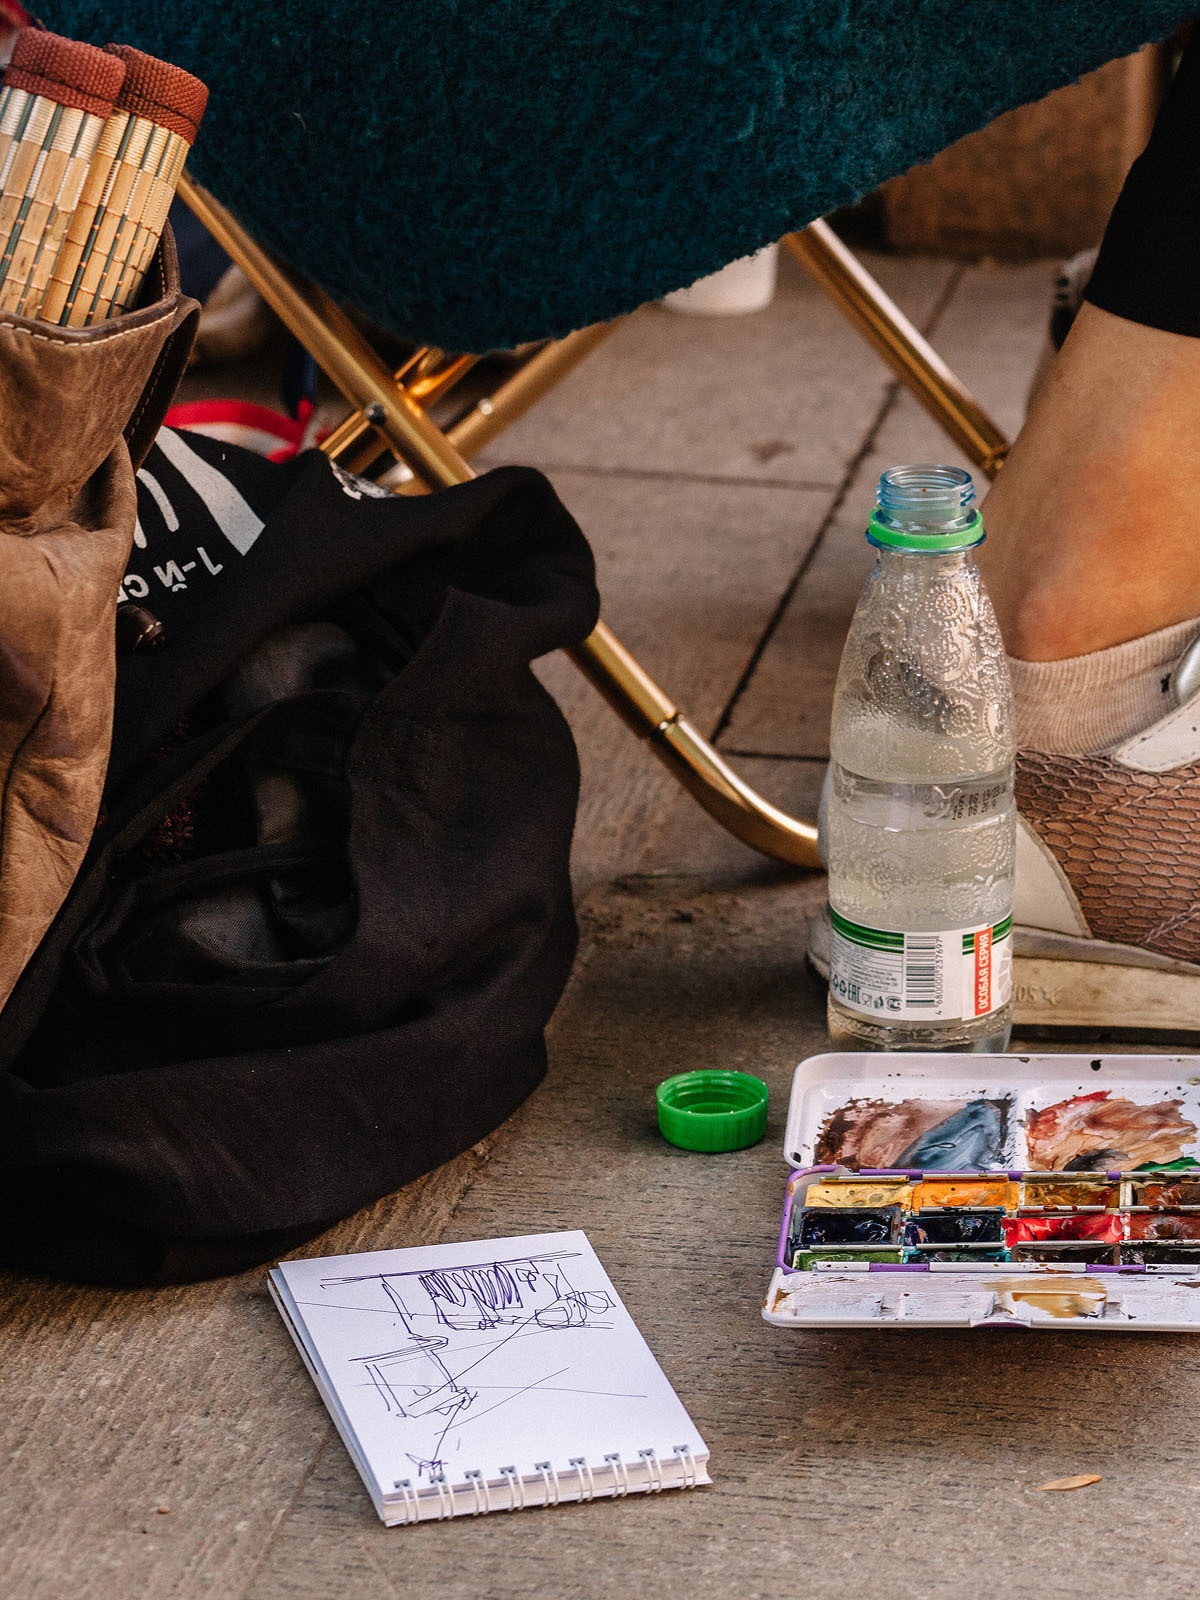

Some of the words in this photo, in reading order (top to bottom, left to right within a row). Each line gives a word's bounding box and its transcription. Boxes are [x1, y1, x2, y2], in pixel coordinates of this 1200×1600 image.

[935, 938, 944, 971] 237697
[978, 932, 990, 967] СЕРИЯ
[935, 973, 943, 1005] 680000
[978, 968, 989, 1010] ОСОБАЯ
